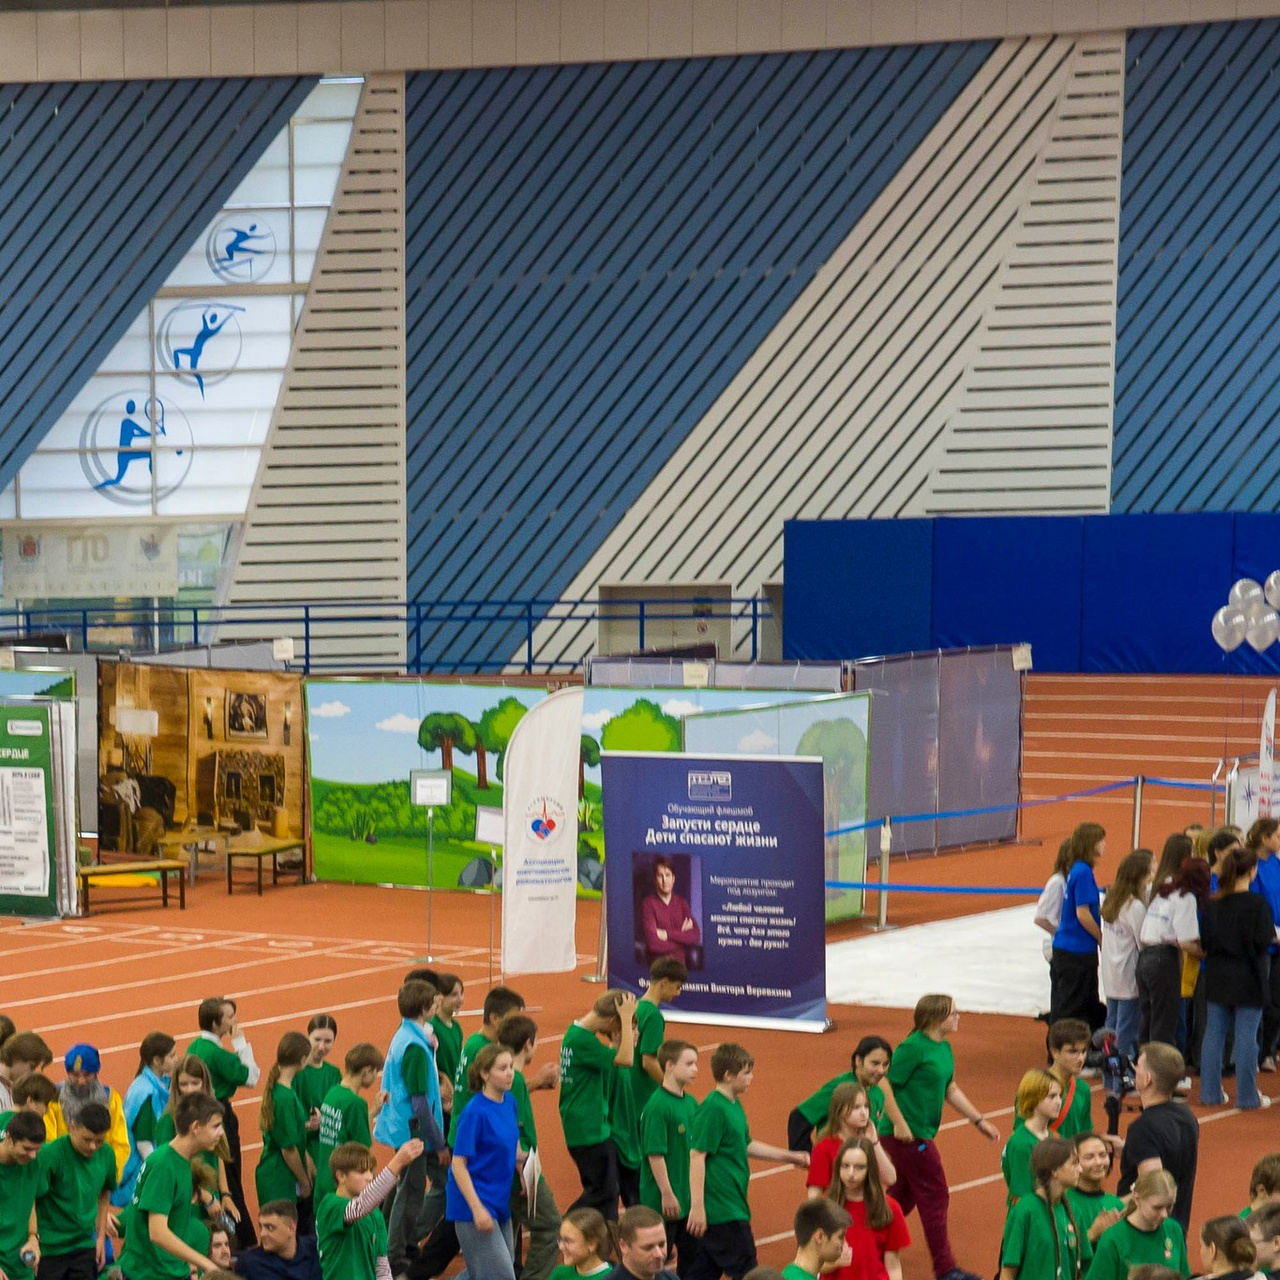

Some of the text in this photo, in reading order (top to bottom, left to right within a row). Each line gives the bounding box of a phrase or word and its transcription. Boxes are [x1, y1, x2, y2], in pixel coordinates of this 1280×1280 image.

[667, 803, 754, 818] Обучающий флешмоб
[661, 815, 761, 836] Запусти сердце
[645, 828, 778, 848] Дети спасают жизни
[711, 982, 745, 996] Виктора
[746, 984, 792, 998] Веревкина
